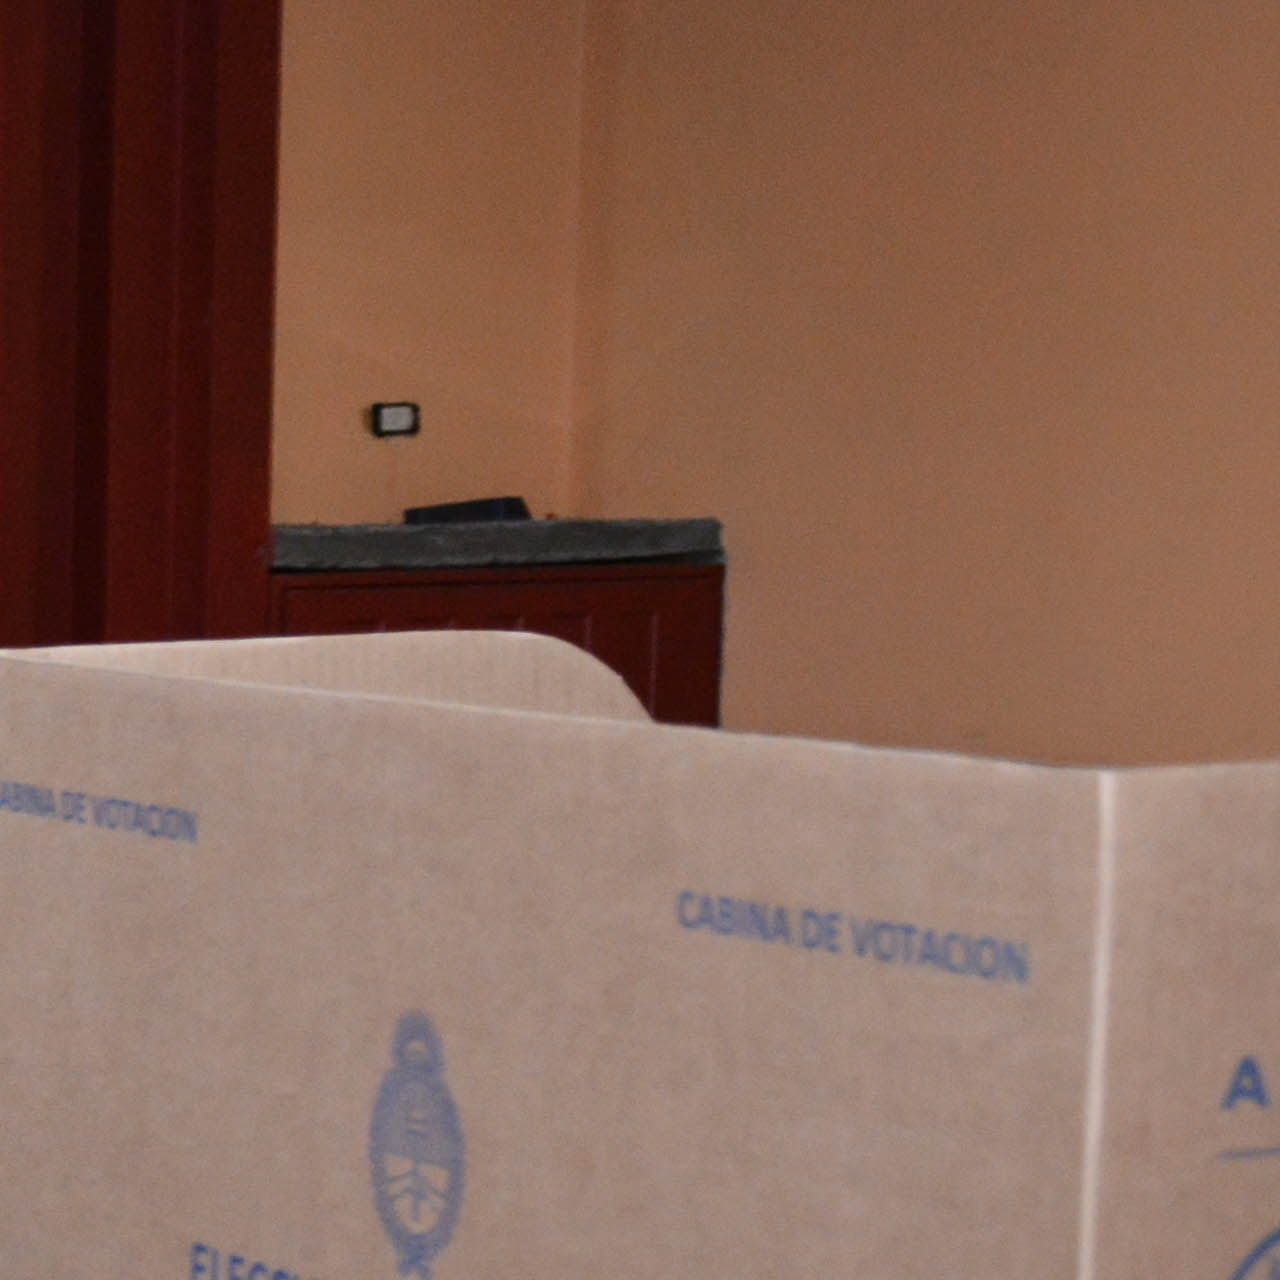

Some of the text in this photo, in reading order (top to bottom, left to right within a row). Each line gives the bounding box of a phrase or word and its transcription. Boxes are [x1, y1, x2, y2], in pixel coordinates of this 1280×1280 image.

[61, 791, 88, 825] DE
[677, 889, 1031, 984] CABINA DE VOTACION
